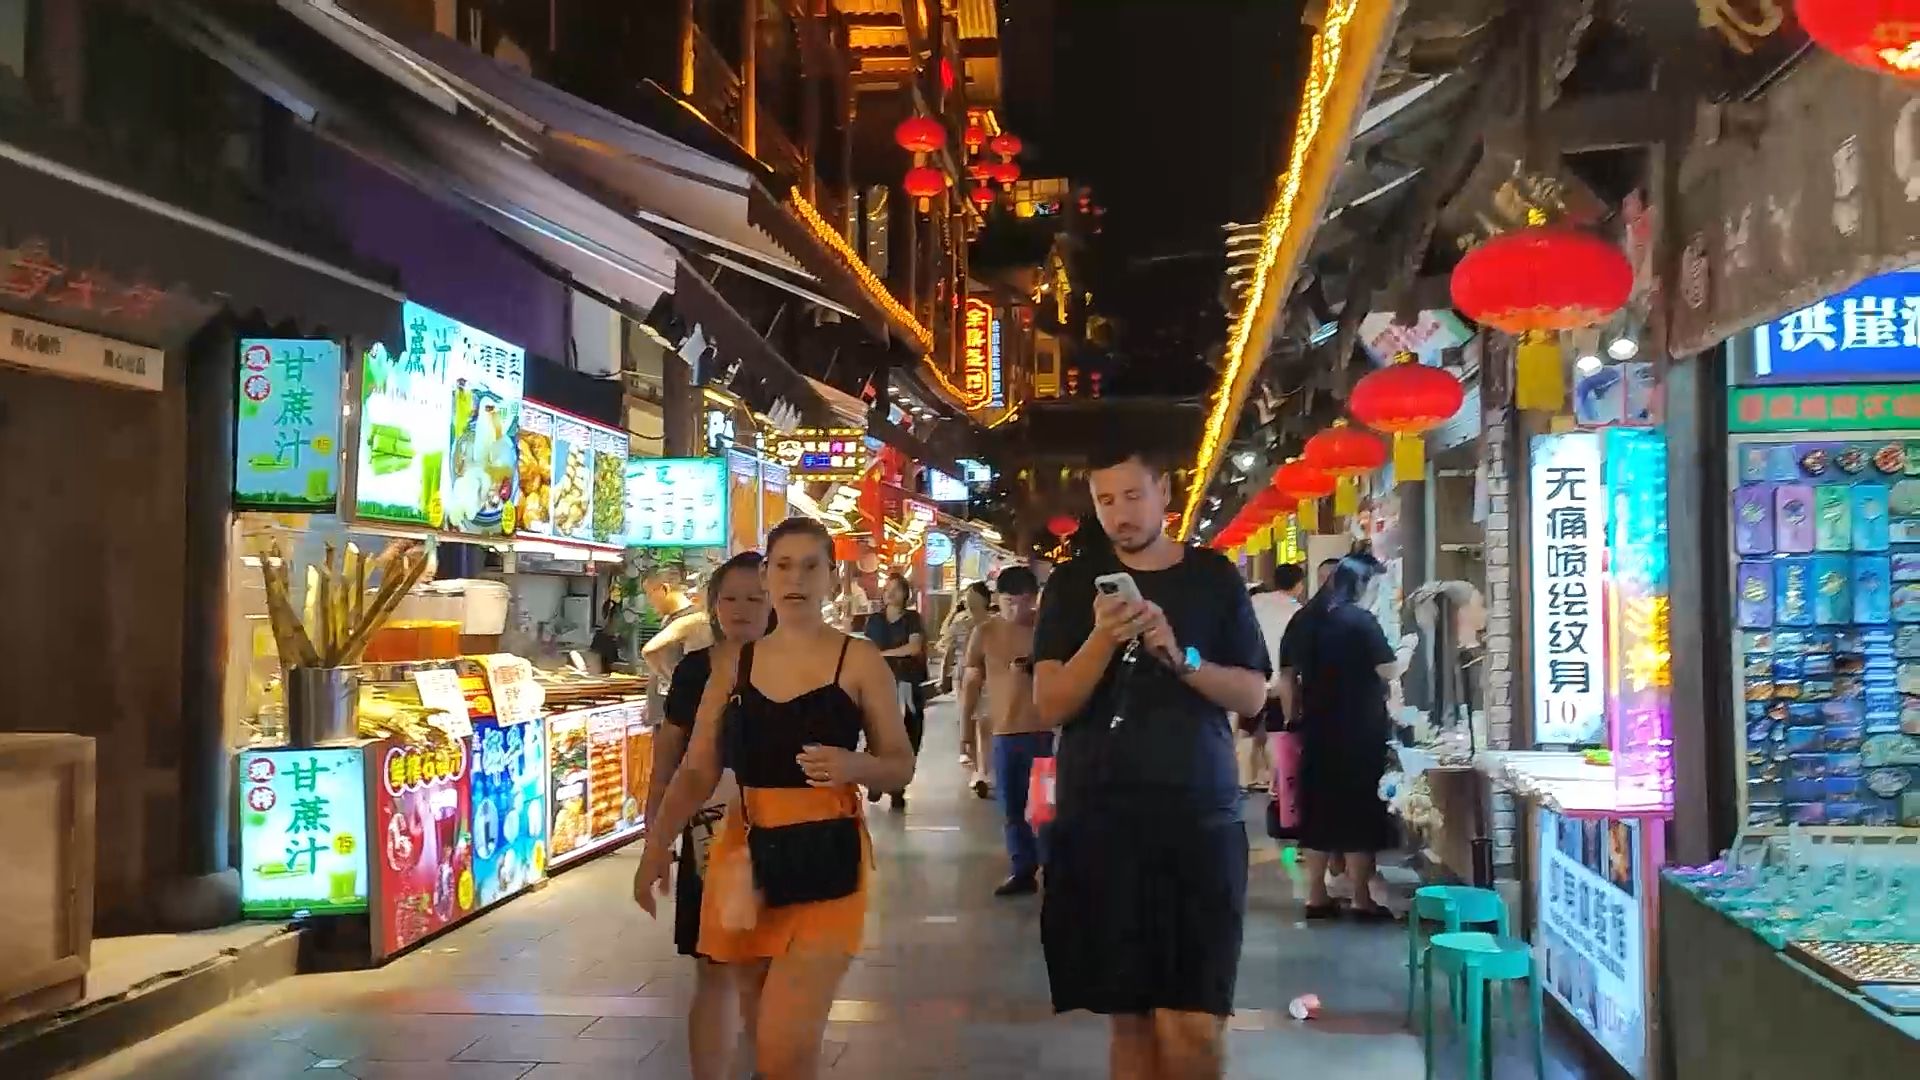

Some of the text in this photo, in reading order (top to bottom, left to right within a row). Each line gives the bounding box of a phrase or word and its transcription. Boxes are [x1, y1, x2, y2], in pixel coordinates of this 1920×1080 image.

[274, 346, 315, 468] 甘蔗汁
[803, 454, 857, 469] 手工
[1546, 467, 1590, 694] 无痛喷绘纹身
[281, 756, 331, 875] 甘蔗汁
